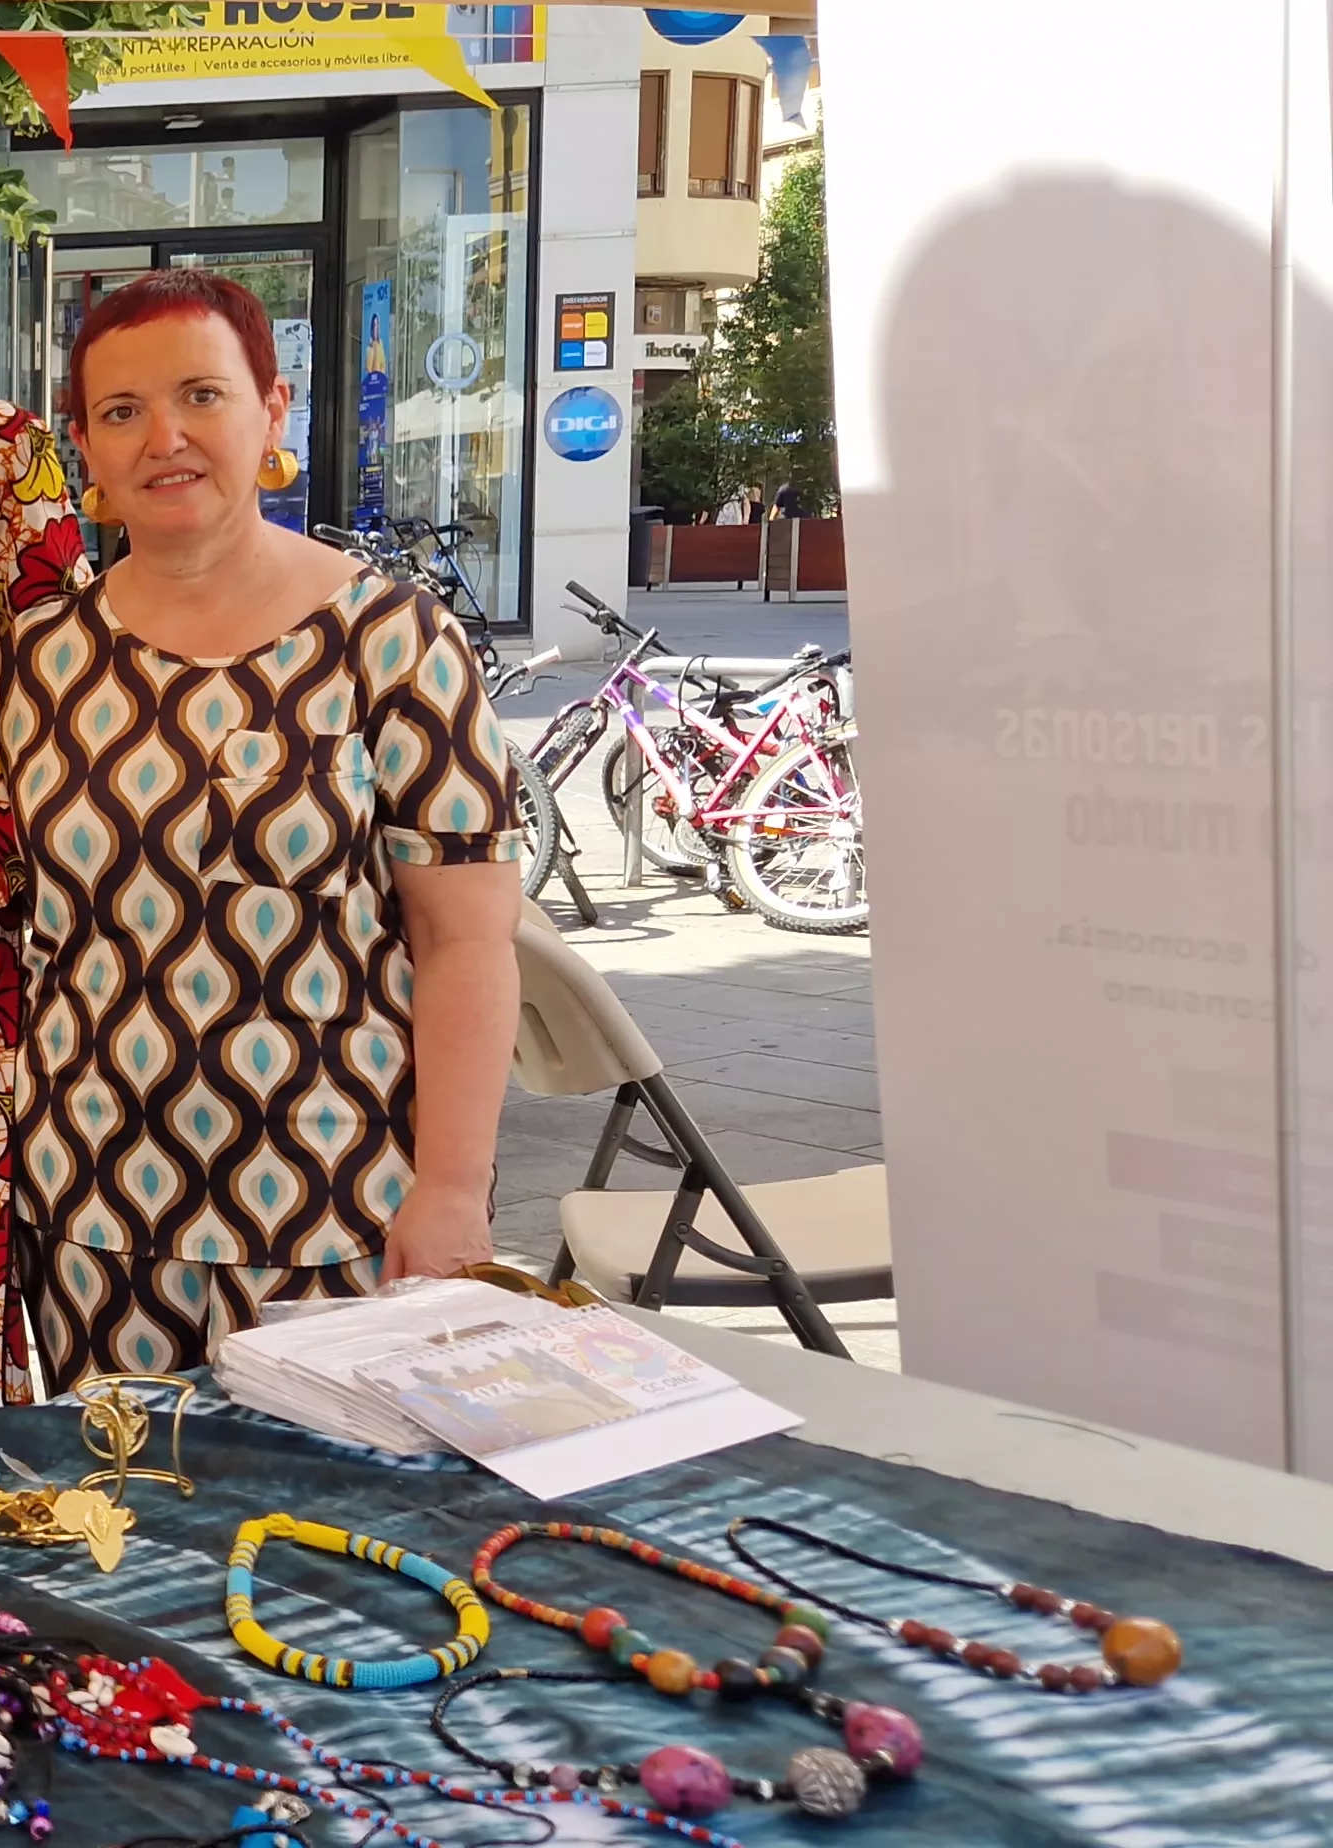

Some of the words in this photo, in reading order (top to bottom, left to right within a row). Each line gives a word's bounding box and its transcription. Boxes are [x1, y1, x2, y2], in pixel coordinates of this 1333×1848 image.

[188, 28, 315, 53] REPARACIÓN
[130, 62, 186, 77] portátiles
[203, 60, 239, 71] Venta
[242, 58, 257, 69] de
[260, 56, 322, 68] accesorios
[324, 58, 331, 69] y
[334, 54, 379, 66] móviles
[382, 52, 413, 64] libre
[550, 415, 617, 433] DIGI
